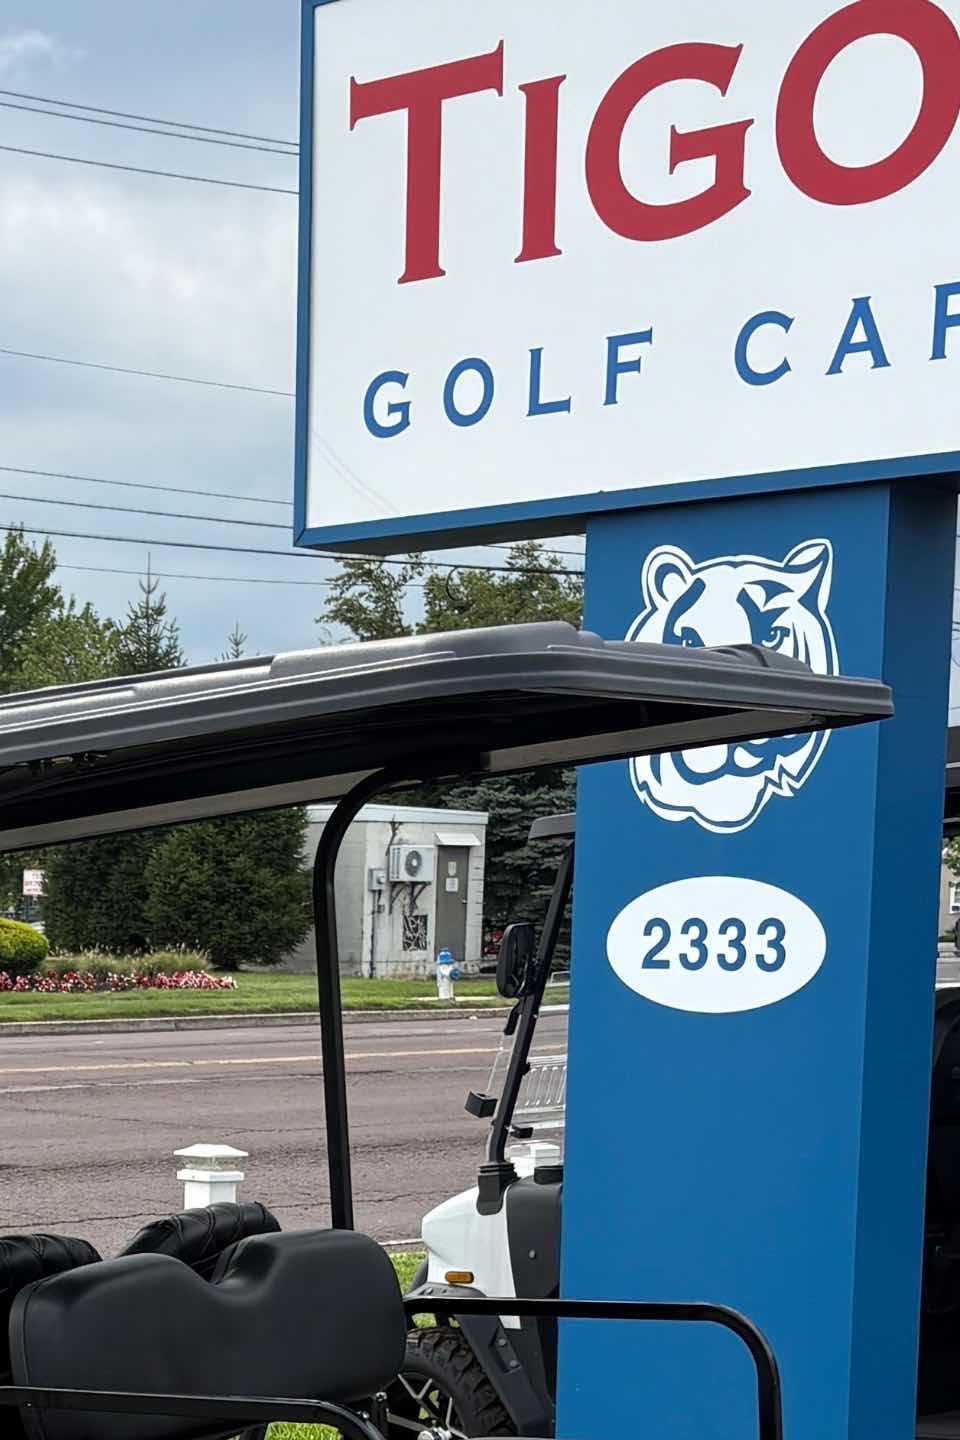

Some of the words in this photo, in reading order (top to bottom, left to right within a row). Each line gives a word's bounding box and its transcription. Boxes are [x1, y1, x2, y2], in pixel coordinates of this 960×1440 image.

[350, 0, 960, 284] TIGO
[363, 328, 653, 439] GOLF
[641, 917, 786, 972] 2333
